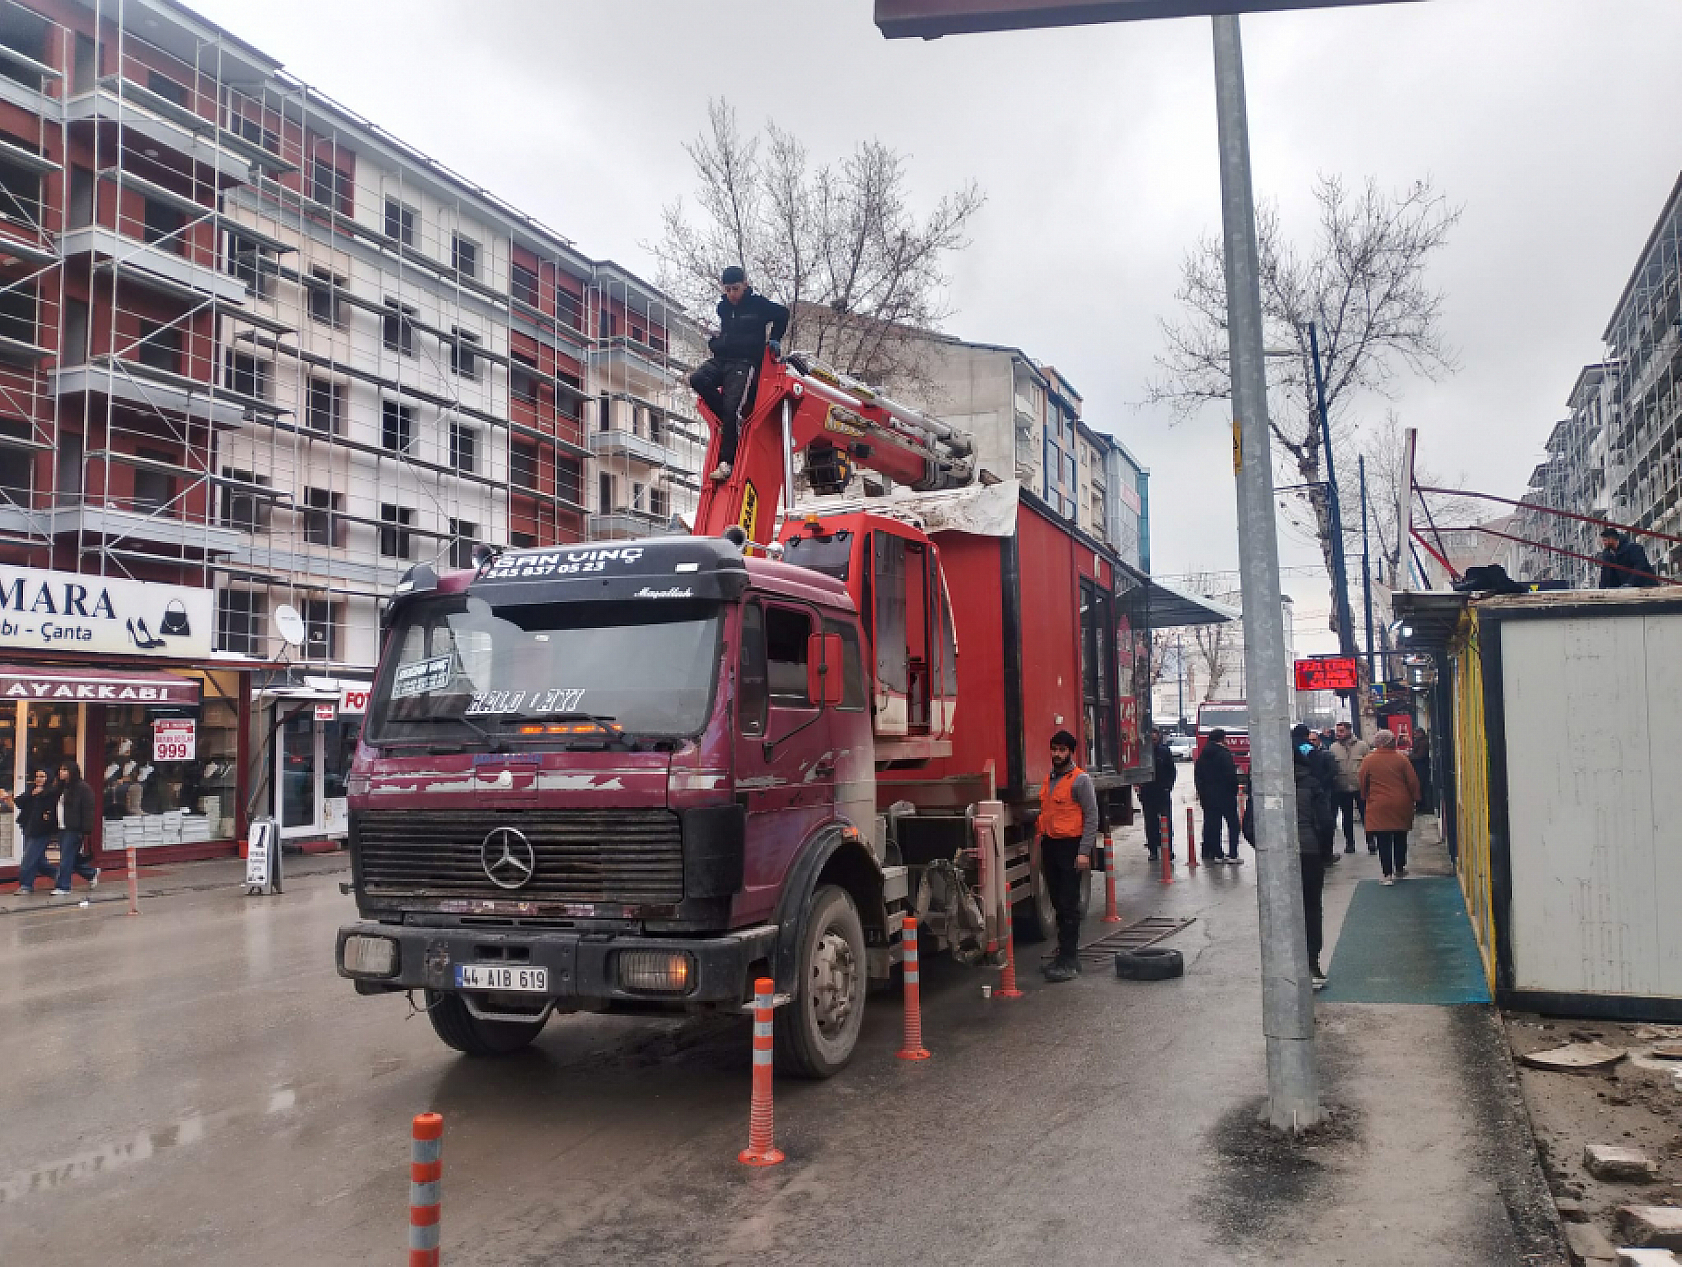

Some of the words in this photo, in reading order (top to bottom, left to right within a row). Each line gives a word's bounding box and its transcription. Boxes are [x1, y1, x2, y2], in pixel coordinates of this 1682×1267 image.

[0, 577, 117, 619] MARA
[41, 621, 92, 643] Çanta
[5, 681, 168, 701] AYAKKABI
[157, 743, 187, 760] 999
[463, 967, 479, 986] 44
[487, 969, 512, 987] AIB
[519, 970, 545, 989] 619
